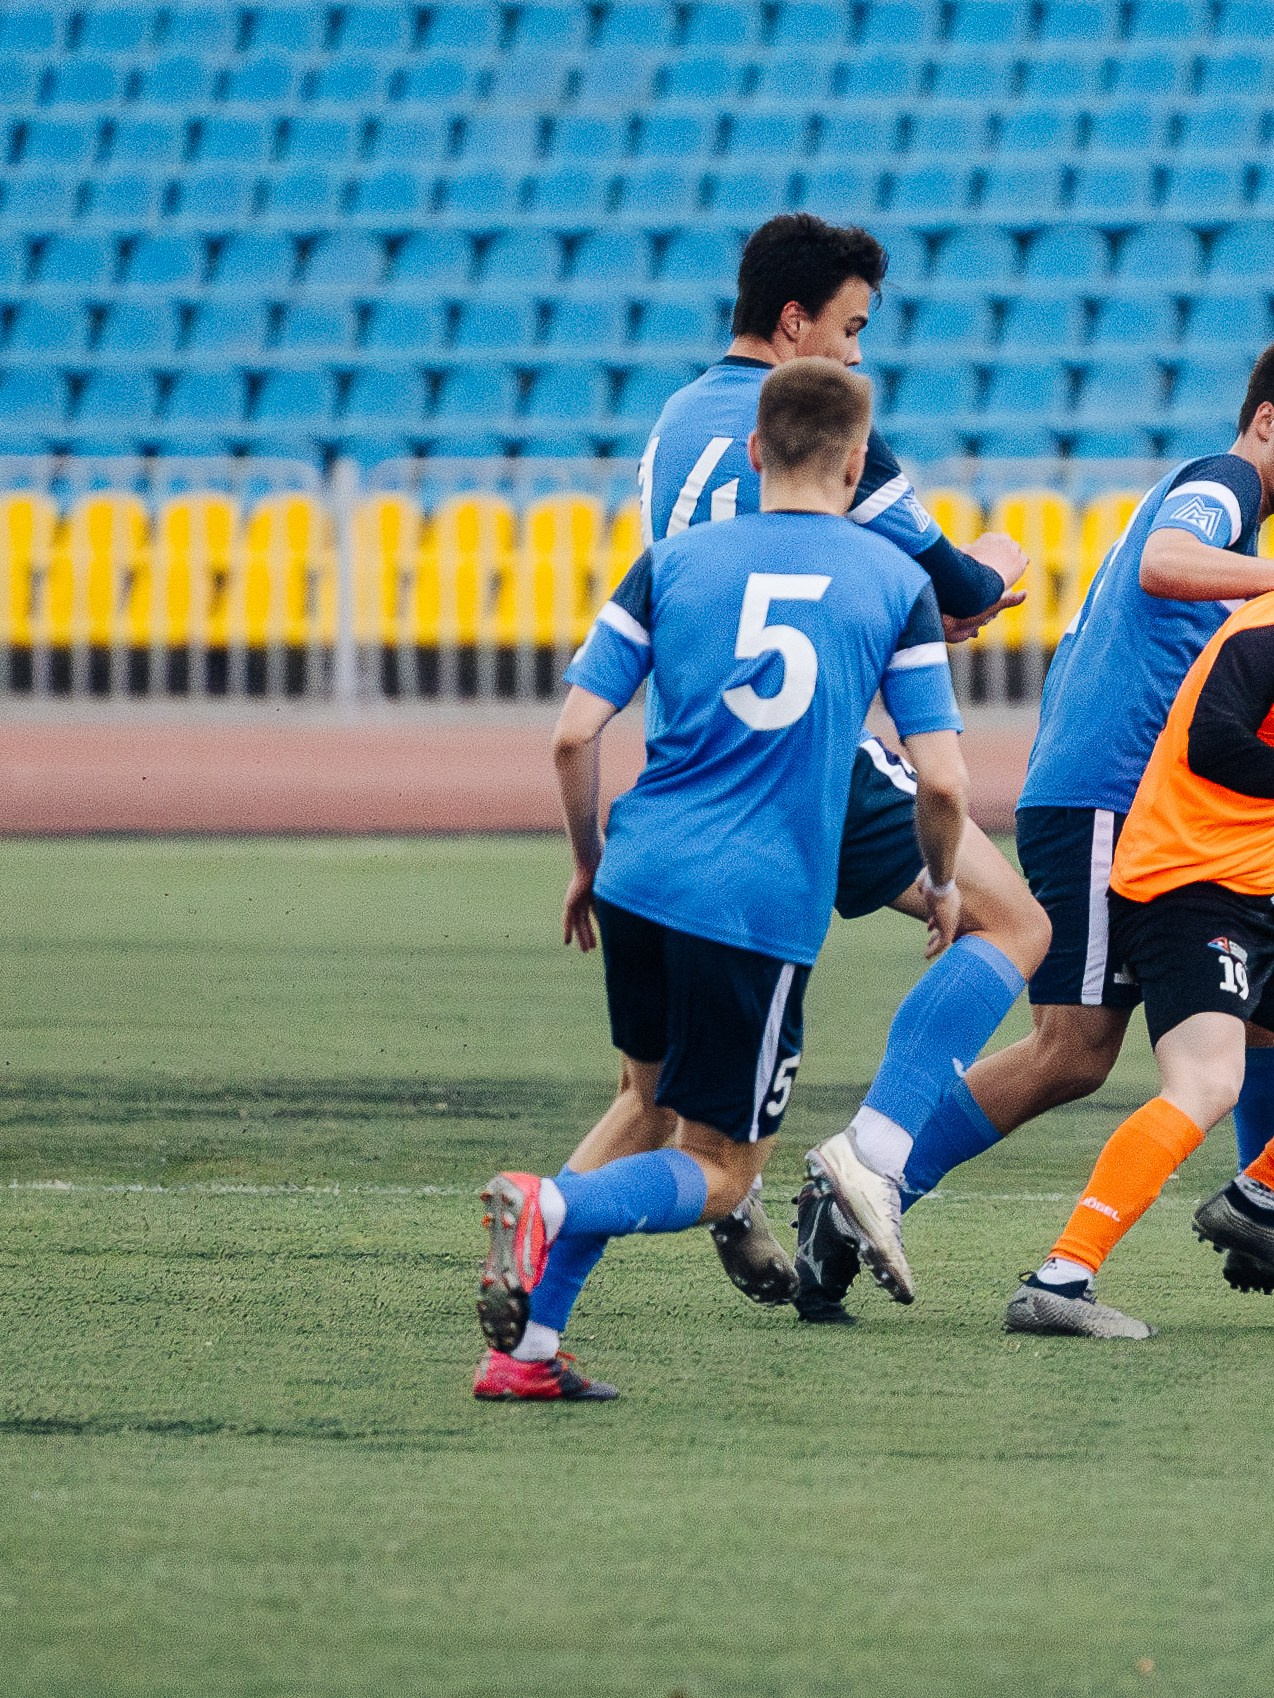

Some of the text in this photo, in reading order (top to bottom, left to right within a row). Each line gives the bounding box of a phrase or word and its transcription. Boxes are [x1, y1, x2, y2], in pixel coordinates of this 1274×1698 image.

[722, 572, 832, 732] 5
[1218, 954, 1250, 1001] 19
[766, 1052, 802, 1117] 5
